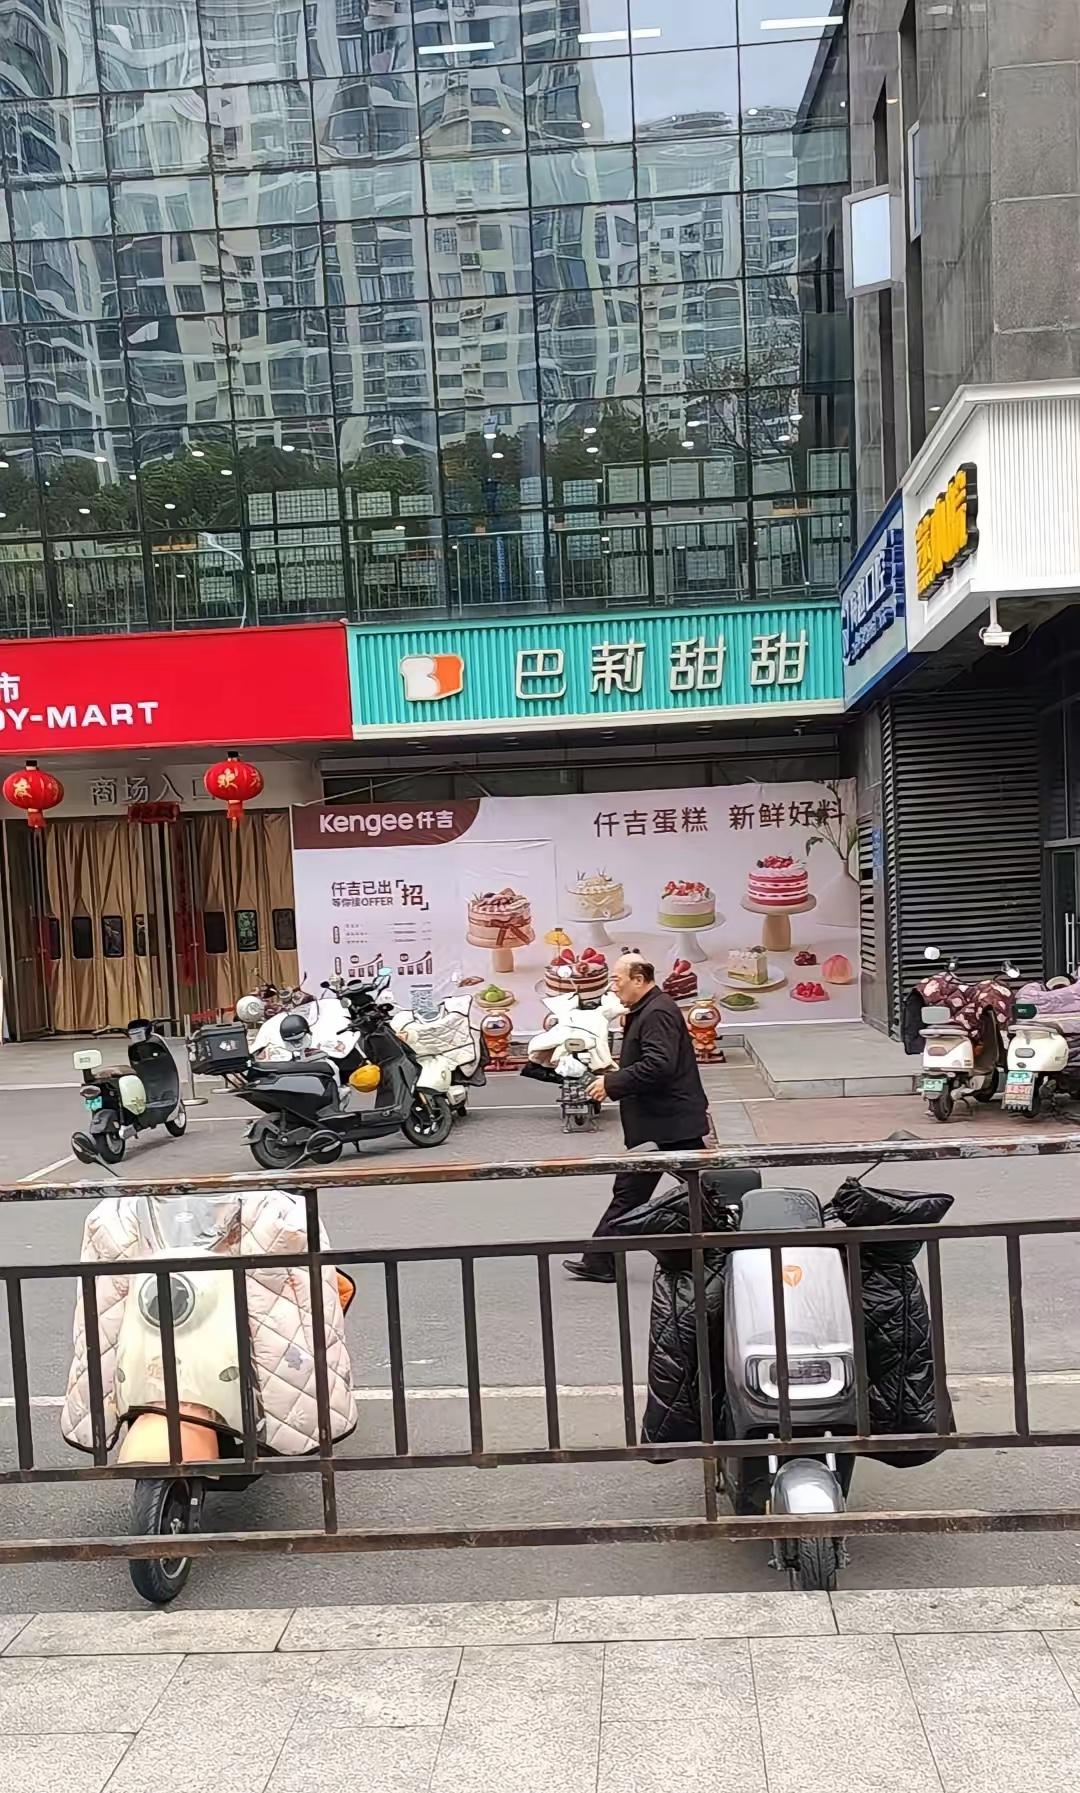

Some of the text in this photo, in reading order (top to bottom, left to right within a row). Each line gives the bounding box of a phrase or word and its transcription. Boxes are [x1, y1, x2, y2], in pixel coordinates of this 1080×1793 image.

[515, 629, 809, 700] 巴莉甜甜
[0, 701, 160, 731] Y-MART
[319, 809, 454, 837] Kengee 仟吉
[593, 799, 846, 838] 仟吉蛋糕 新鲜好料
